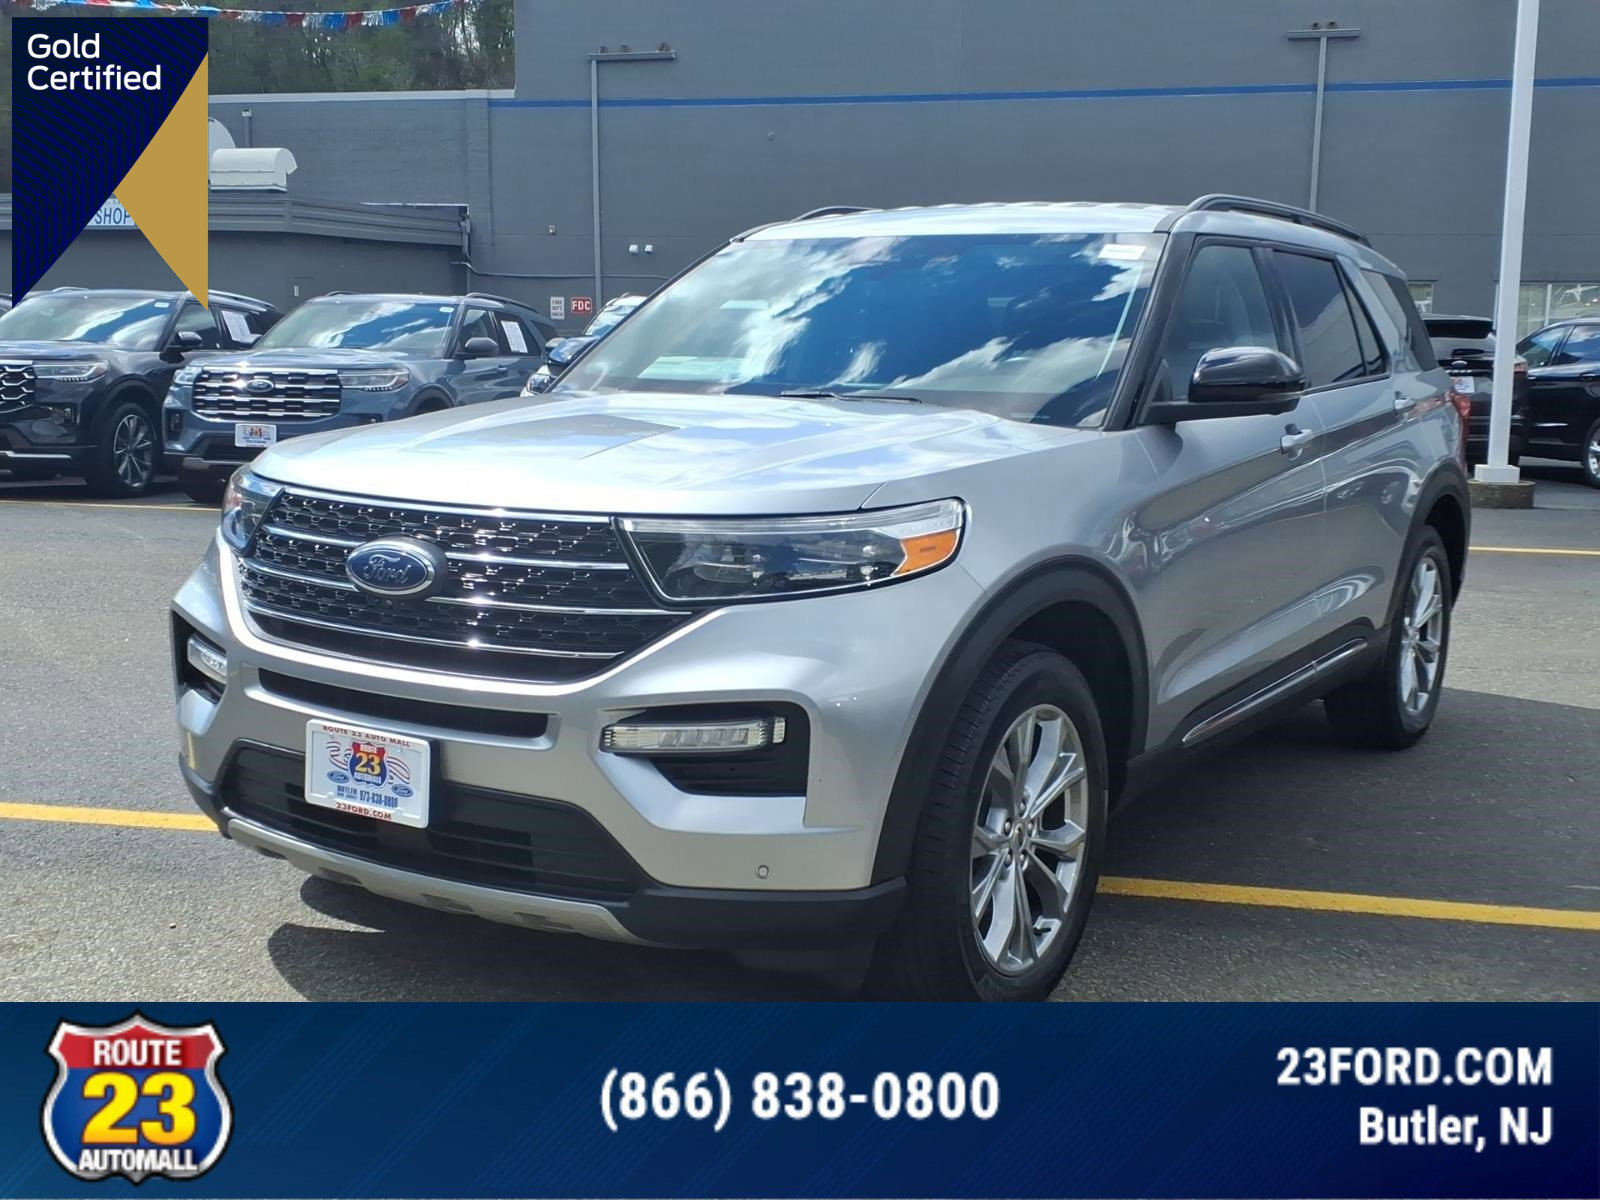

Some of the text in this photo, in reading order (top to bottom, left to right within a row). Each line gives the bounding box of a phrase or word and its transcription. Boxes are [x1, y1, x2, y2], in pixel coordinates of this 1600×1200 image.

[572, 300, 591, 311] FDC
[363, 554, 412, 585] Ford
[322, 725, 348, 735] ROUTE
[365, 733, 386, 742] AUTO
[389, 737, 411, 747] MALL
[355, 753, 381, 775] 23
[335, 802, 392, 820] 23FORD.COM
